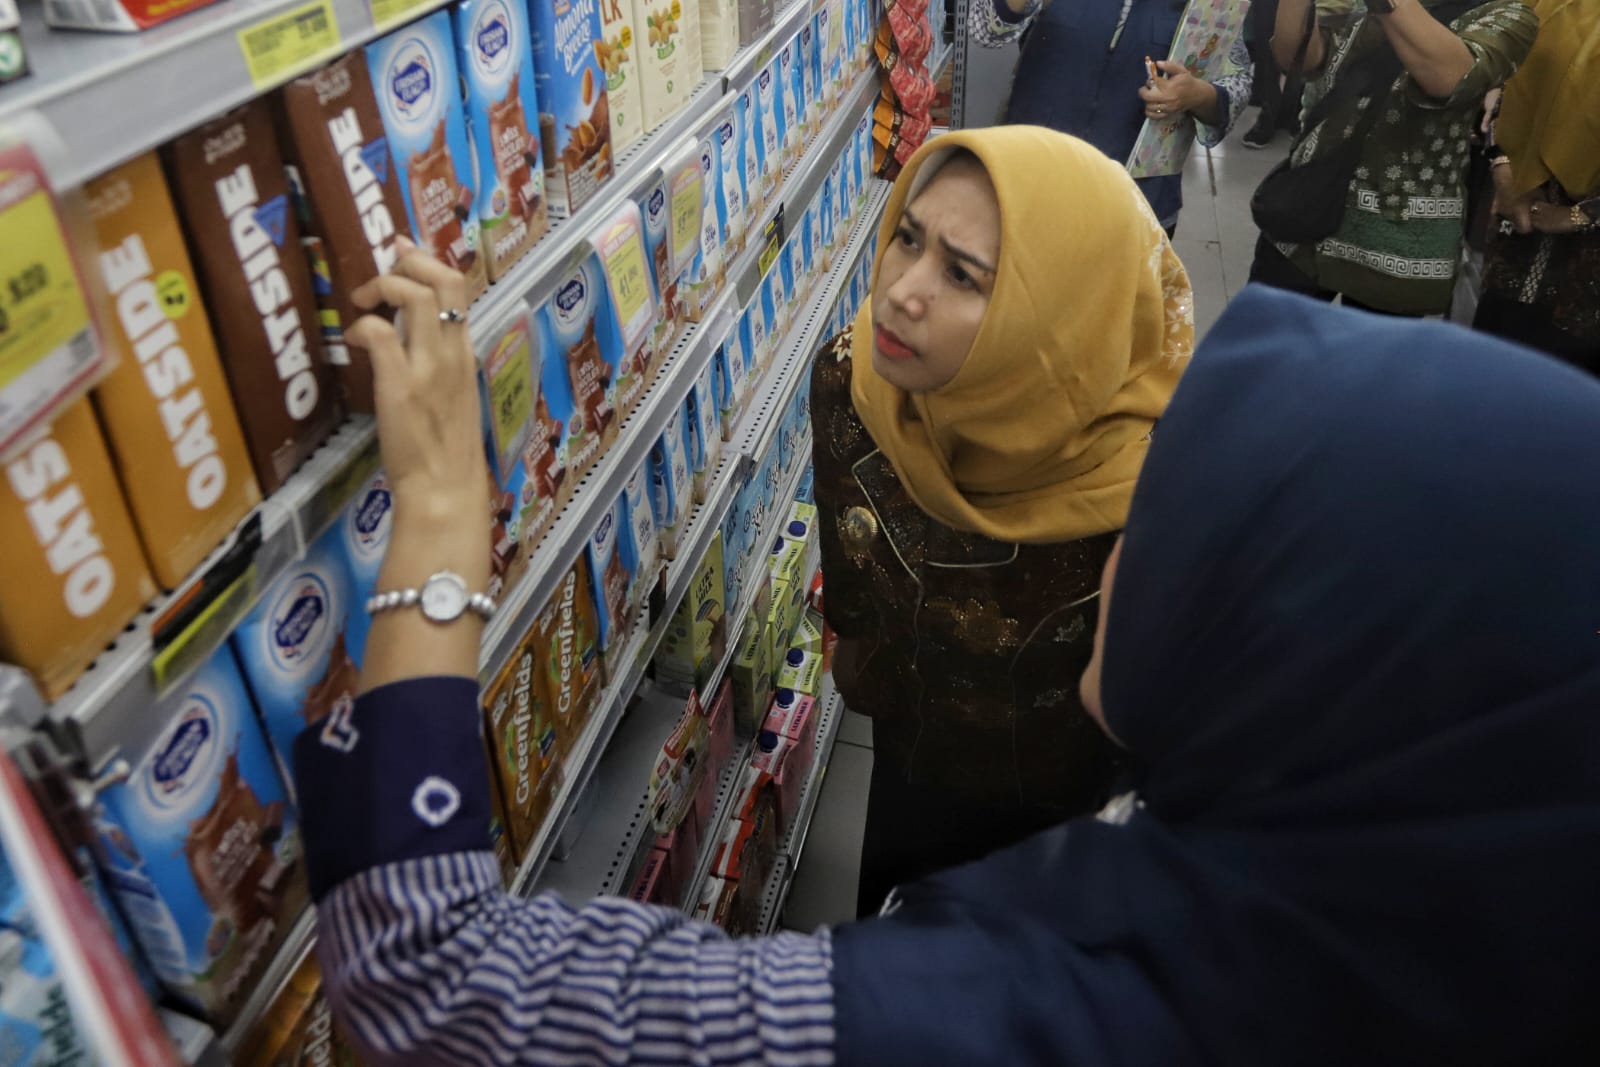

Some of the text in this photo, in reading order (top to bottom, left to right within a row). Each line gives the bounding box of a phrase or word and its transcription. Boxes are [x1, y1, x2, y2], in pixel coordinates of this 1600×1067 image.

[601, 0, 623, 26] LK
[328, 107, 397, 276] TSIDE
[100, 232, 227, 510] OATSIDE
[215, 163, 319, 421] OATSIDE
[6, 434, 115, 618] OATS
[558, 569, 577, 713] Greenfields
[512, 652, 533, 805] Greenfields
